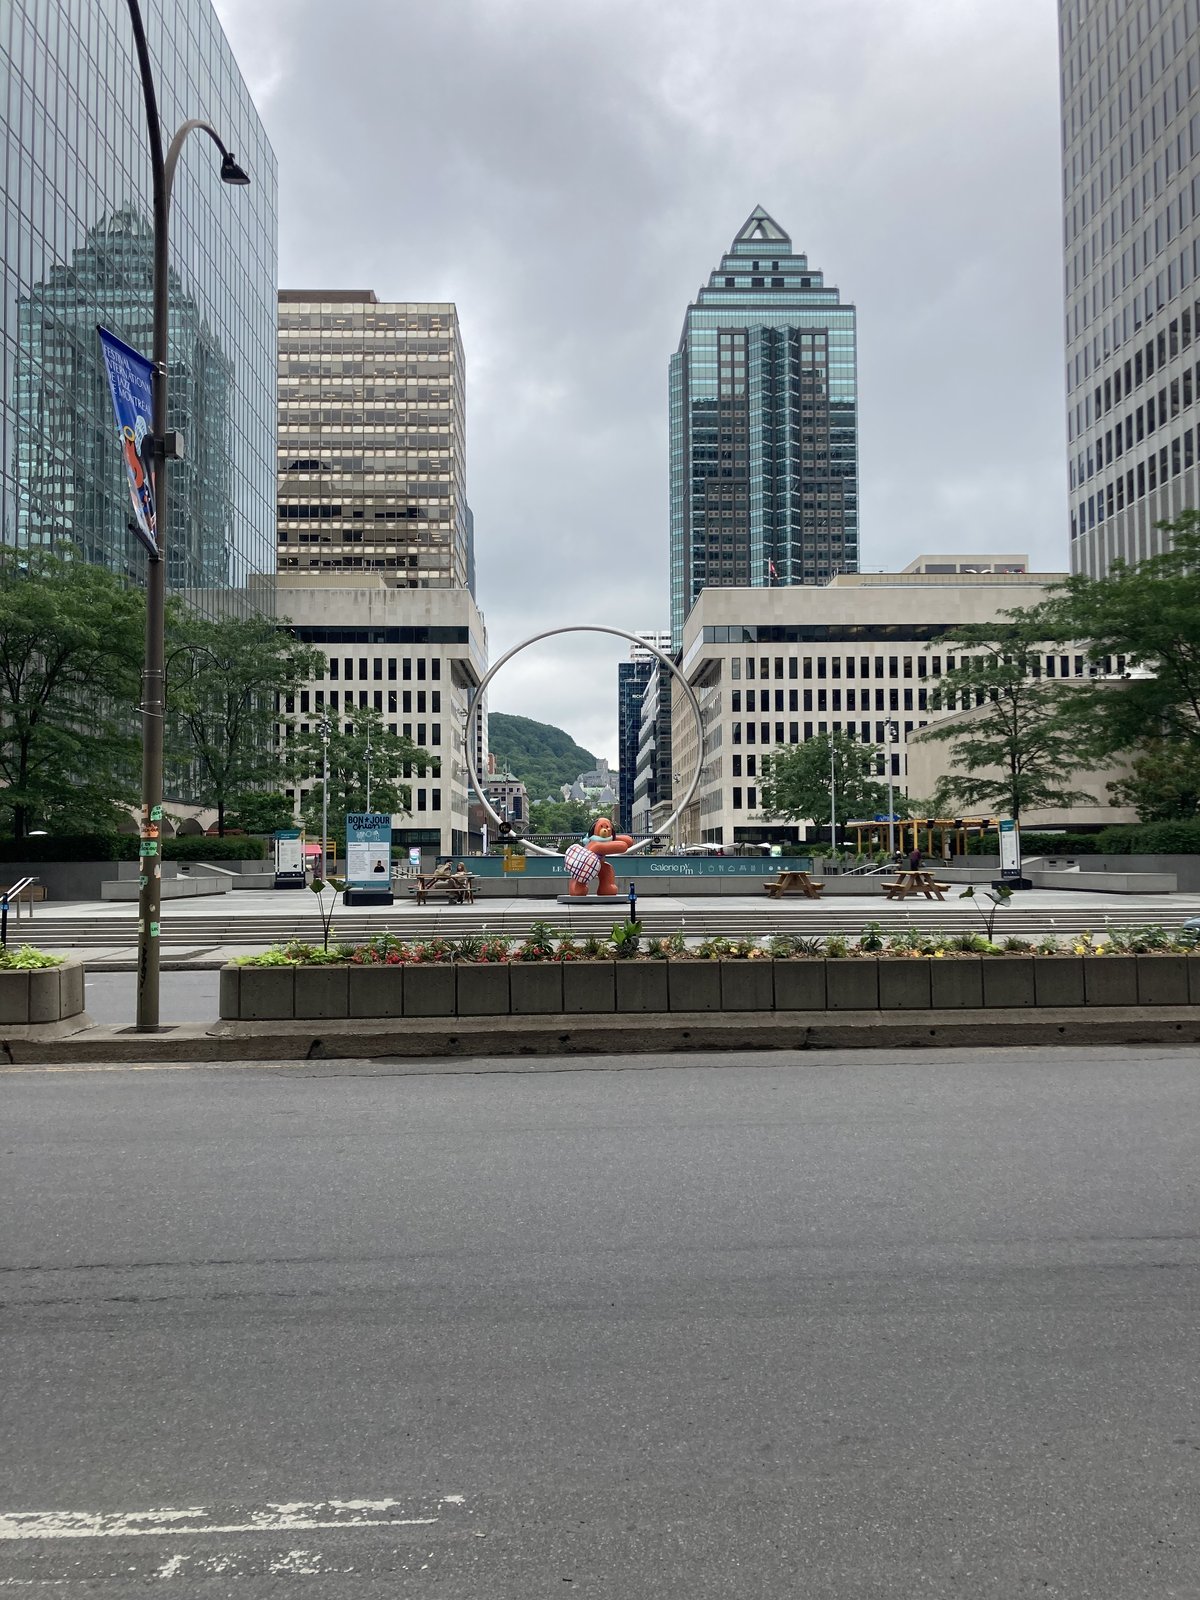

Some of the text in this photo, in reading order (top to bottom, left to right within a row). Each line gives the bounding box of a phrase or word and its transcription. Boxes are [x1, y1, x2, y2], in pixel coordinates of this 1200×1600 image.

[104, 345, 131, 371] FESTIVAL
[106, 358, 152, 396] NTERNATIONAL
[348, 816, 390, 824] BON JOUR
[552, 865, 563, 873] LE
[650, 863, 680, 872] Galerie
